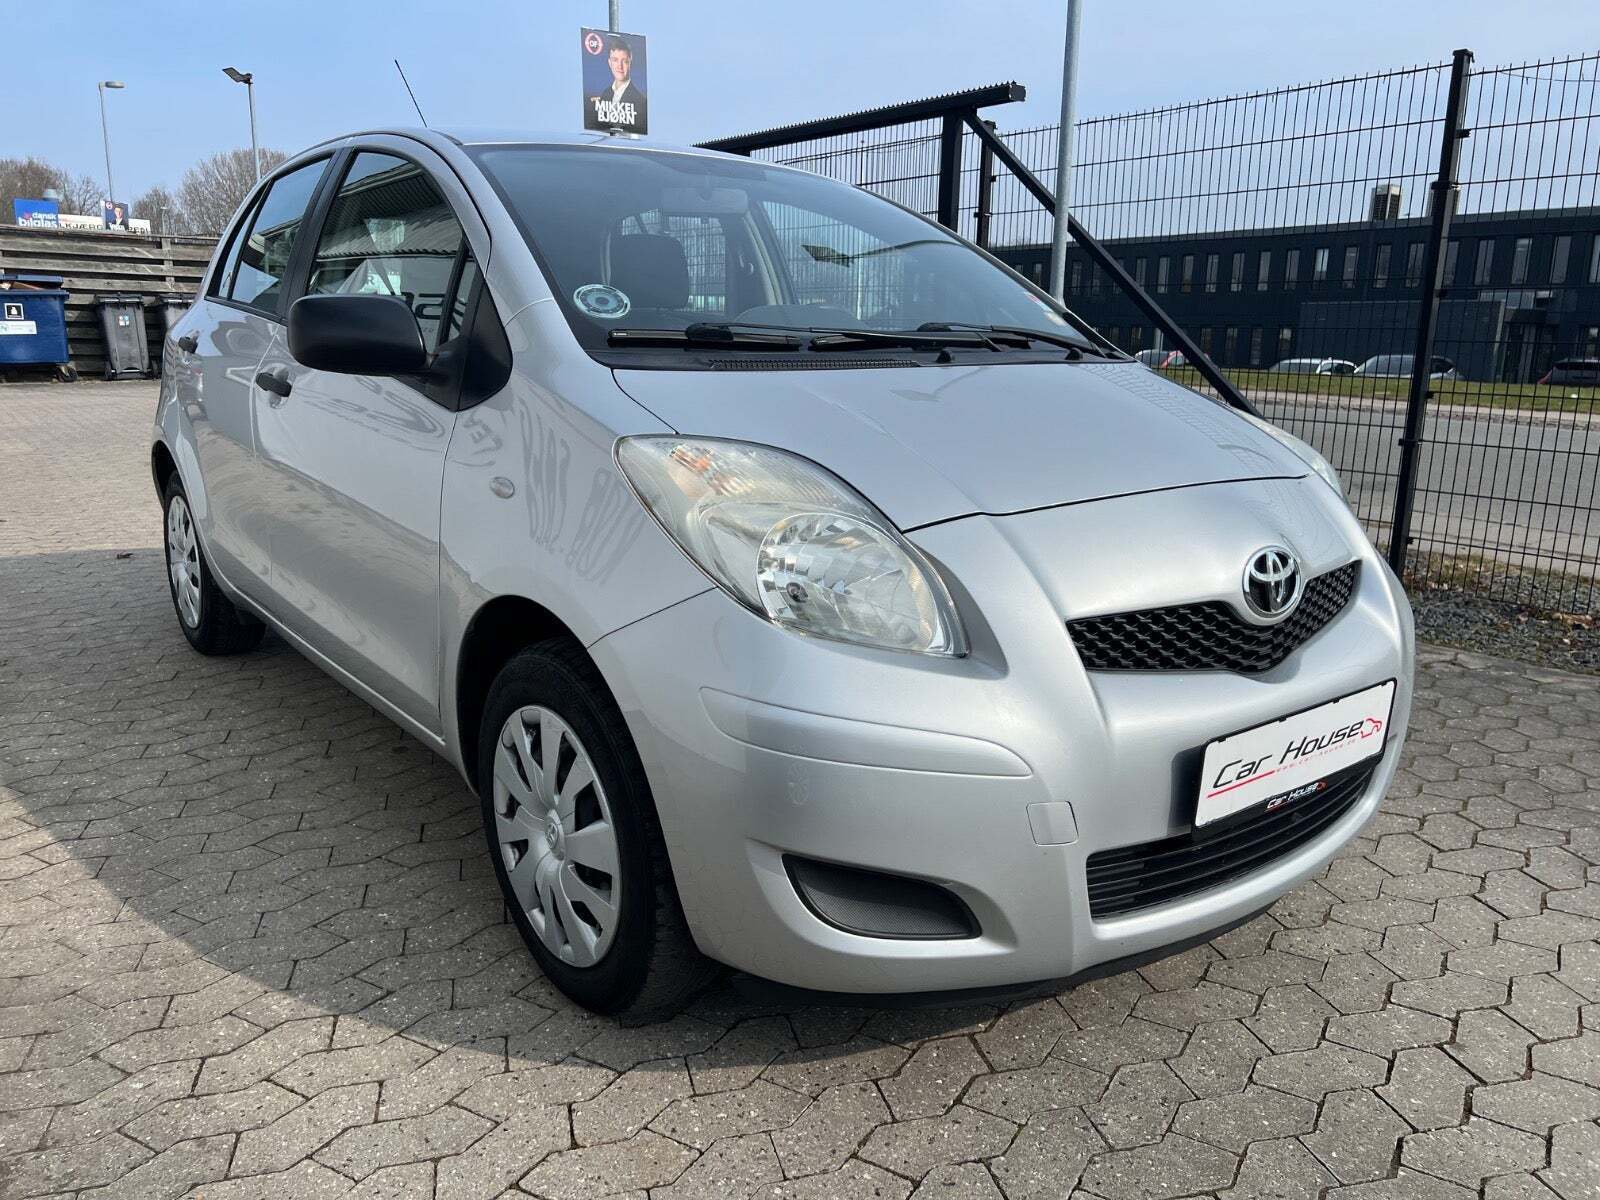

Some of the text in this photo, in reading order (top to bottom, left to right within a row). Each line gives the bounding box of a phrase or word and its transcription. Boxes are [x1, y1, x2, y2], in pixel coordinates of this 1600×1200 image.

[595, 100, 637, 115] MIKKEL
[598, 110, 635, 125] BJØRN
[31, 212, 57, 220] dansk
[1213, 719, 1364, 788] Car House
[1267, 796, 1287, 809] Car
